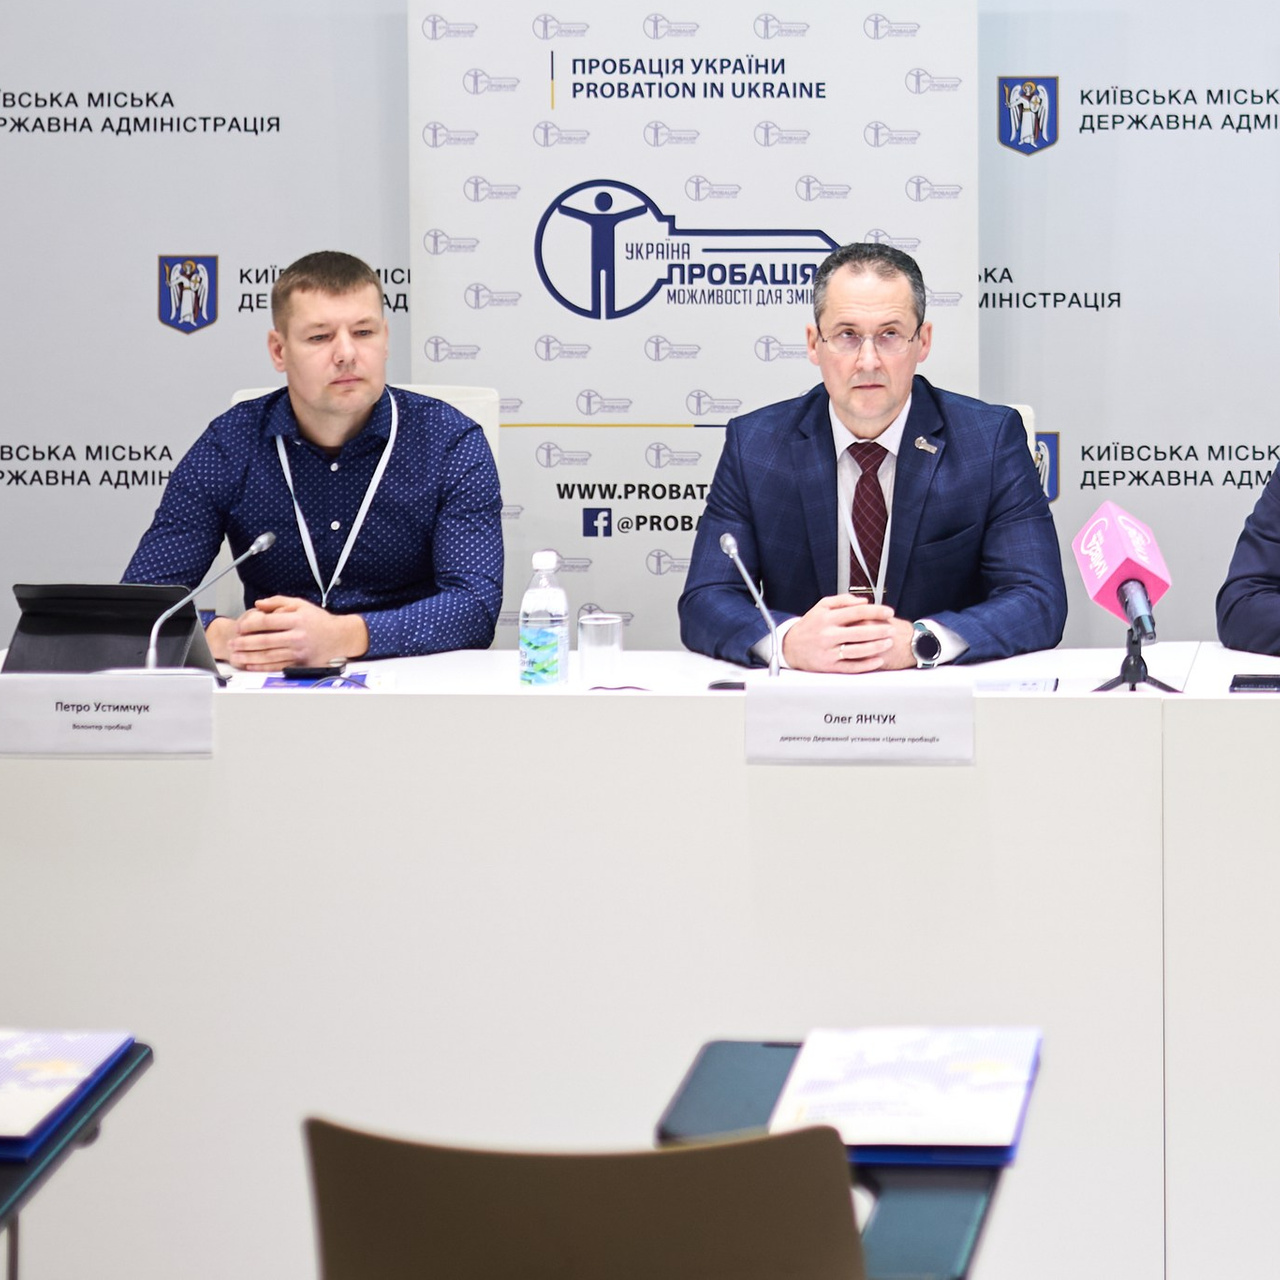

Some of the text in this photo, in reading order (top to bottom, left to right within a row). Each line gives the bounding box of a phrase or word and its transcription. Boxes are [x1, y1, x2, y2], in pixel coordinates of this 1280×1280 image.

[572, 54, 786, 79] ПРОБАЦІЯ УКРАЇНИ
[2, 91, 175, 109] ВСЬКА МІСЬКА
[572, 81, 827, 99] PROBATION IN UKRAINE
[1080, 85, 1198, 106] КИЇВСЬКА
[100, 116, 280, 137] АДМІНІСТРАЦІЯ
[1078, 114, 1213, 134] ДЕРЖАВНА
[625, 238, 691, 260] УКРАЇНА
[667, 263, 818, 285] ПРОБАЦІЯ
[667, 289, 753, 305] МОЖЛИВОСТІ
[756, 289, 782, 306] ДЛЯ
[85, 444, 173, 462] МІСЬКА
[1081, 441, 1199, 462] КИЇВСЬКА
[1079, 470, 1214, 490] ДЕРЖАВНА
[556, 483, 712, 500] WWW.PROBAT
[55, 701, 150, 715] Петро Устимчук
[823, 713, 896, 724] Олег ЯНЧУК
